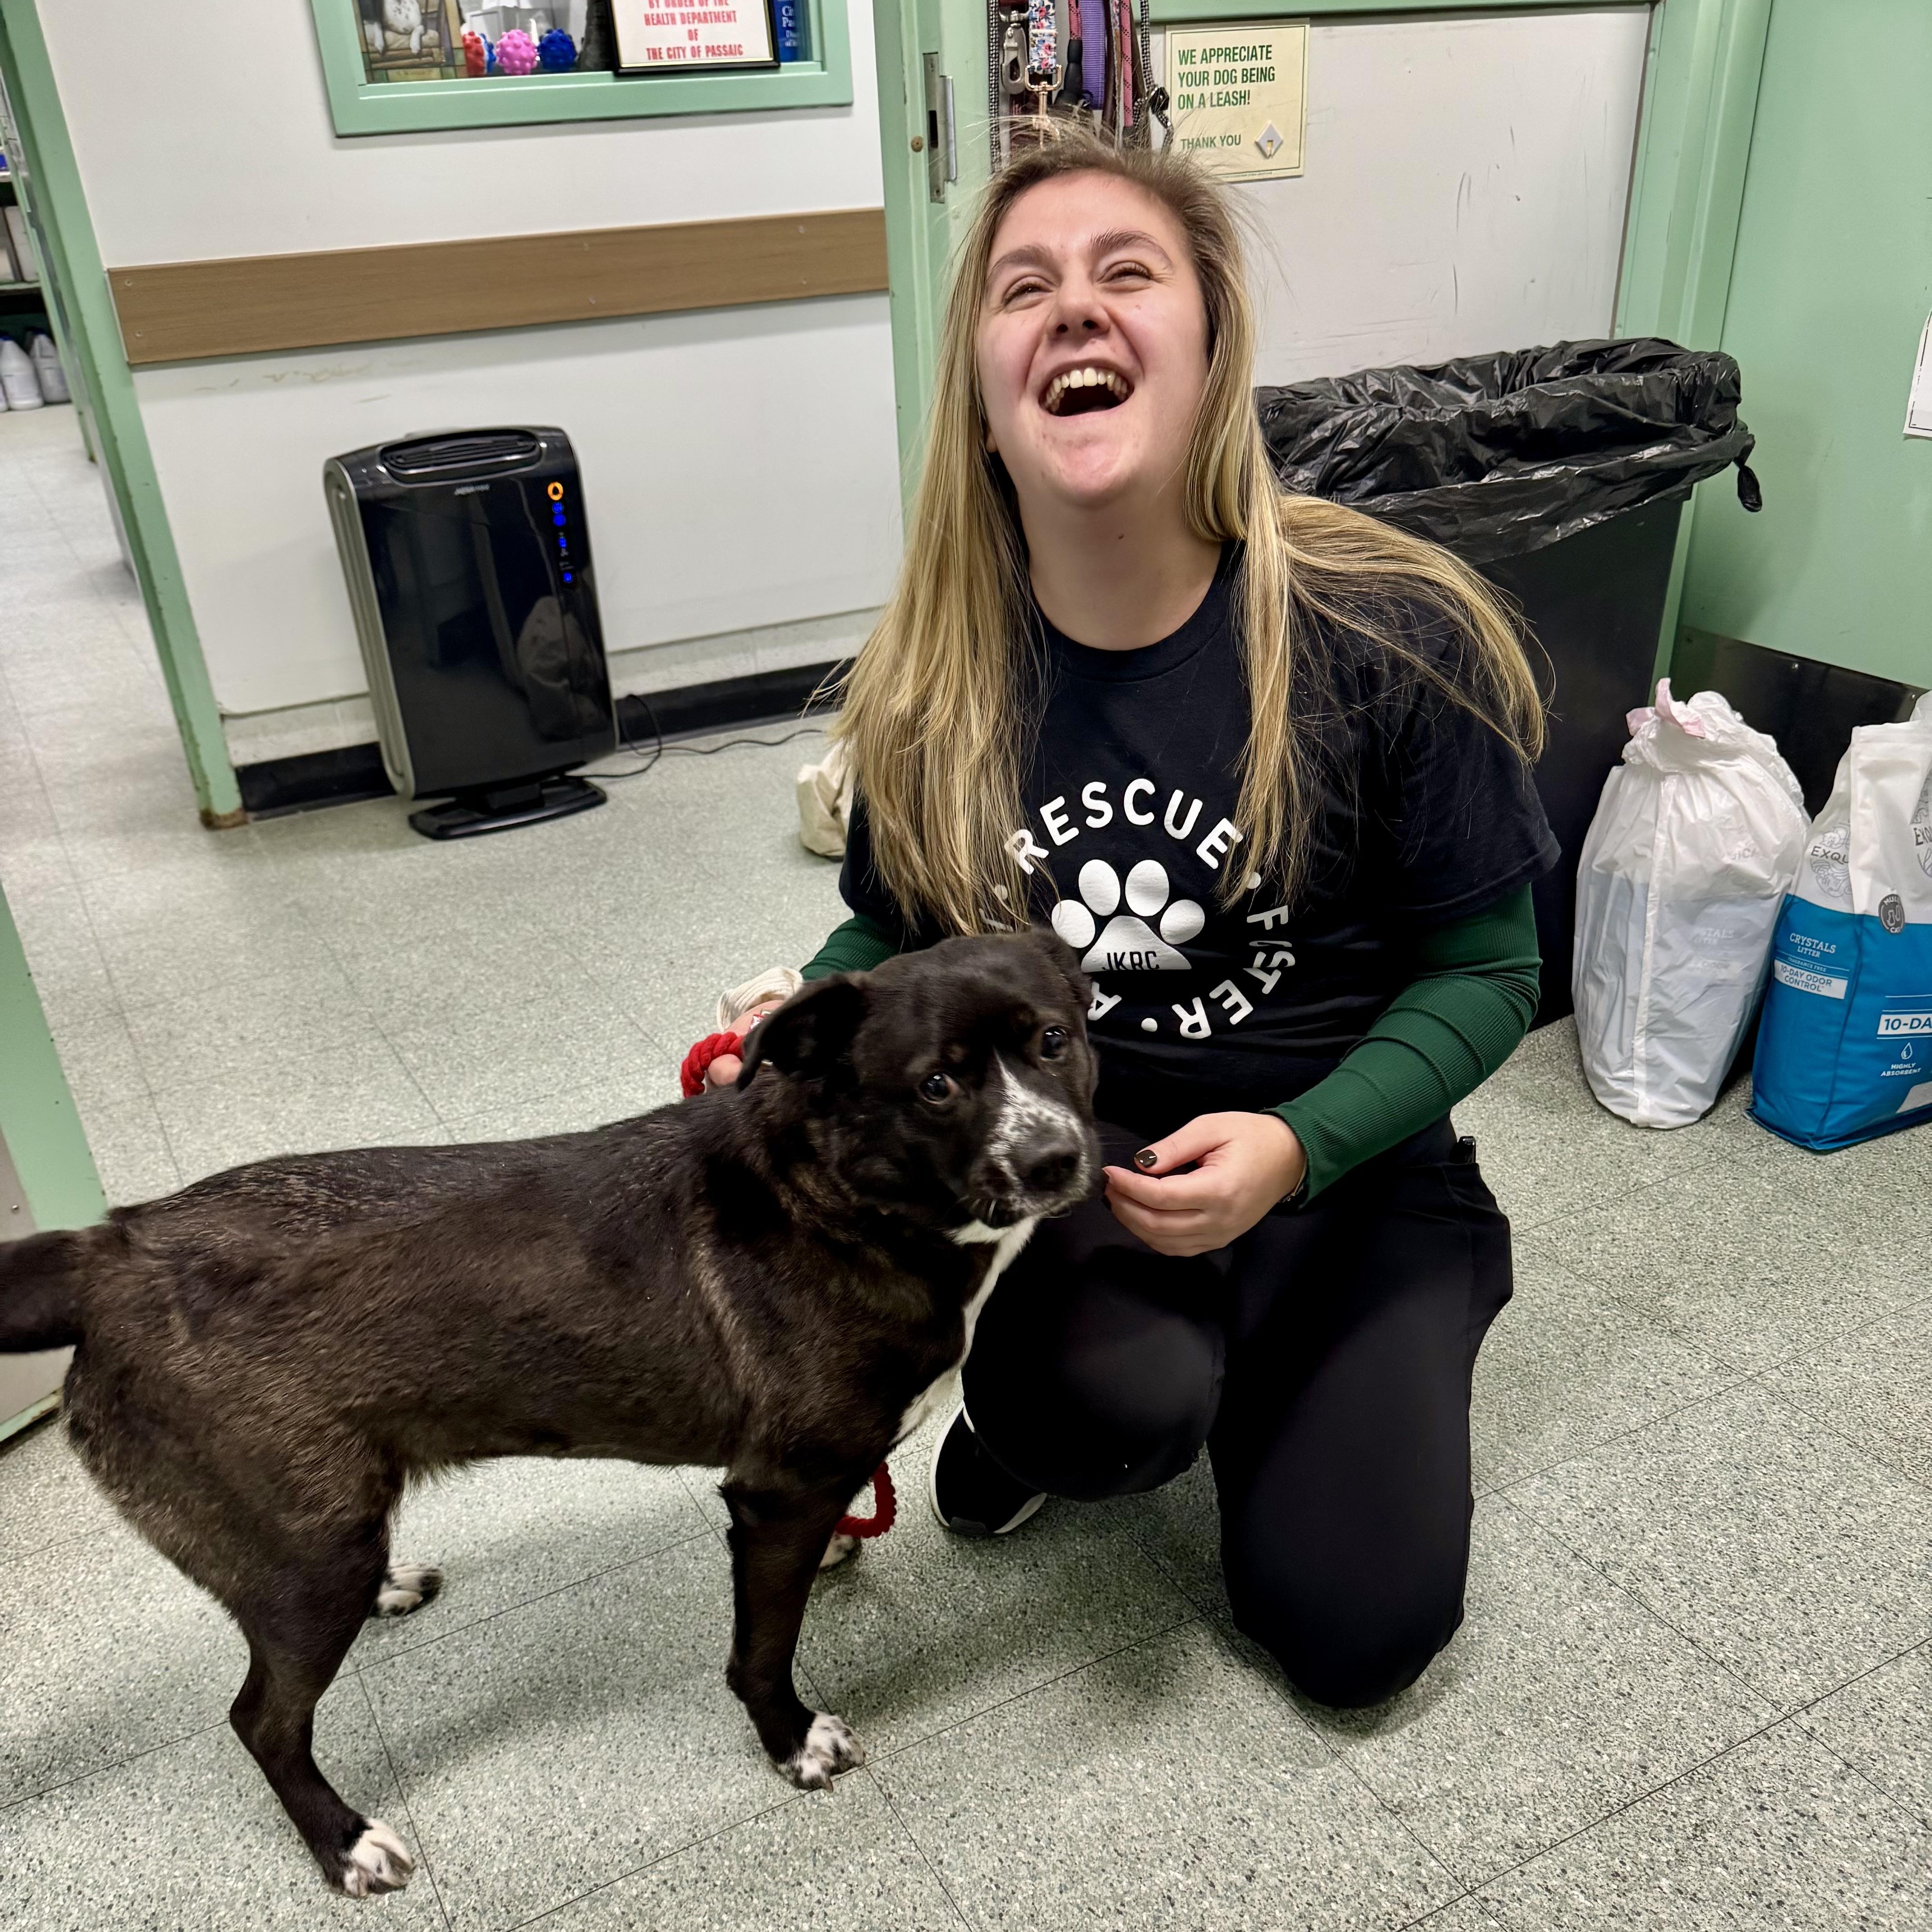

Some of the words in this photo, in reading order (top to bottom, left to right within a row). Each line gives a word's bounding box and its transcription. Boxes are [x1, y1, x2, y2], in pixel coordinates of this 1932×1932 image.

[649, 0, 660, 8] BY
[644, 13, 677, 26] HEALTH
[680, 10, 737, 24] DEPARTMENT
[688, 29, 699, 41] OF
[646, 47, 663, 60] THE
[667, 46, 686, 60] CITY
[690, 46, 700, 58] OF
[705, 44, 743, 57] PASSAIC
[1178, 49, 1196, 65] WE
[1200, 45, 1272, 64] APPRECIATE
[1178, 70, 1210, 87] YOUR
[1214, 69, 1237, 86] DOG
[1241, 66, 1275, 83] BEING
[1178, 93, 1194, 110] ON
[1198, 93, 1205, 108] A
[1210, 90, 1250, 108] LEASH!
[1181, 136, 1216, 150] THANK
[1220, 134, 1241, 147] YOU
[1004, 778, 1244, 875] RESCUE
[1789, 933, 1836, 954] CRYSTALS
[1797, 946, 1821, 957] LITTER
[1102, 951, 1160, 970] JKRC
[1788, 957, 1812, 968] FRAGRANCE
[1780, 965, 1805, 978] 10-DAY
[1806, 974, 1832, 986] ODOR
[1881, 1068, 1921, 1076] ABSORBENT
